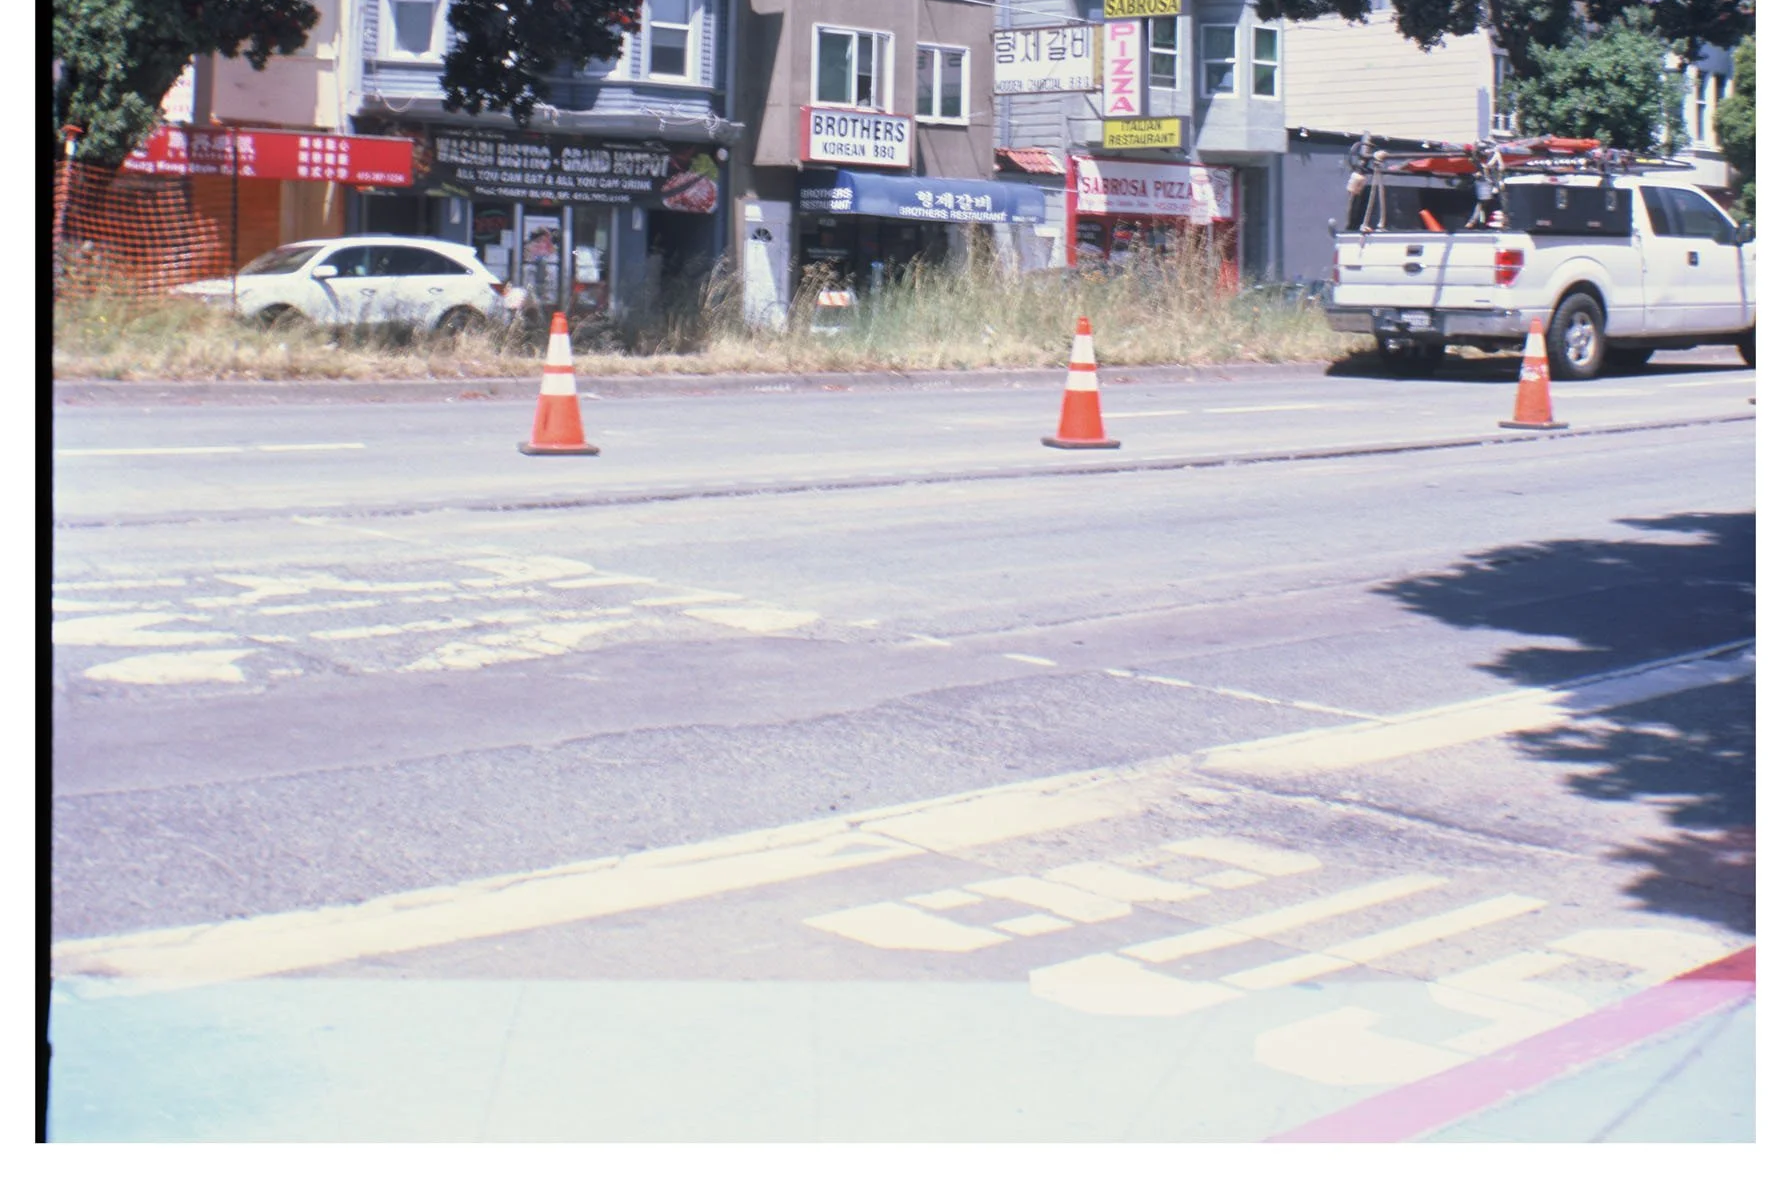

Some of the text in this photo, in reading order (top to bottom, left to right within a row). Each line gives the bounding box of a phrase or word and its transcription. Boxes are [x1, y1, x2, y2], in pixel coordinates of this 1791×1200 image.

[1110, 22, 1136, 113] PIZZA
[813, 115, 905, 143] BROTHERS
[1120, 120, 1162, 132] ITALIAN
[1108, 132, 1176, 146] RESTAURANT
[496, 142, 552, 170] BISTRO
[561, 147, 611, 174] GRAND
[822, 142, 896, 160] KOREAN BBQ
[477, 169, 499, 182] YOU
[500, 171, 523, 183] CAN
[555, 175, 575, 187] ALL
[576, 176, 597, 188] YOU
[599, 178, 620, 189] CAN
[1082, 176, 1194, 200] SABROSA PIZZA
[800, 187, 854, 200] BROTHERS
[898, 205, 949, 220] BROTHERS
[950, 209, 1008, 222] RESTAURANT
[802, 835, 1739, 1087] BUS
